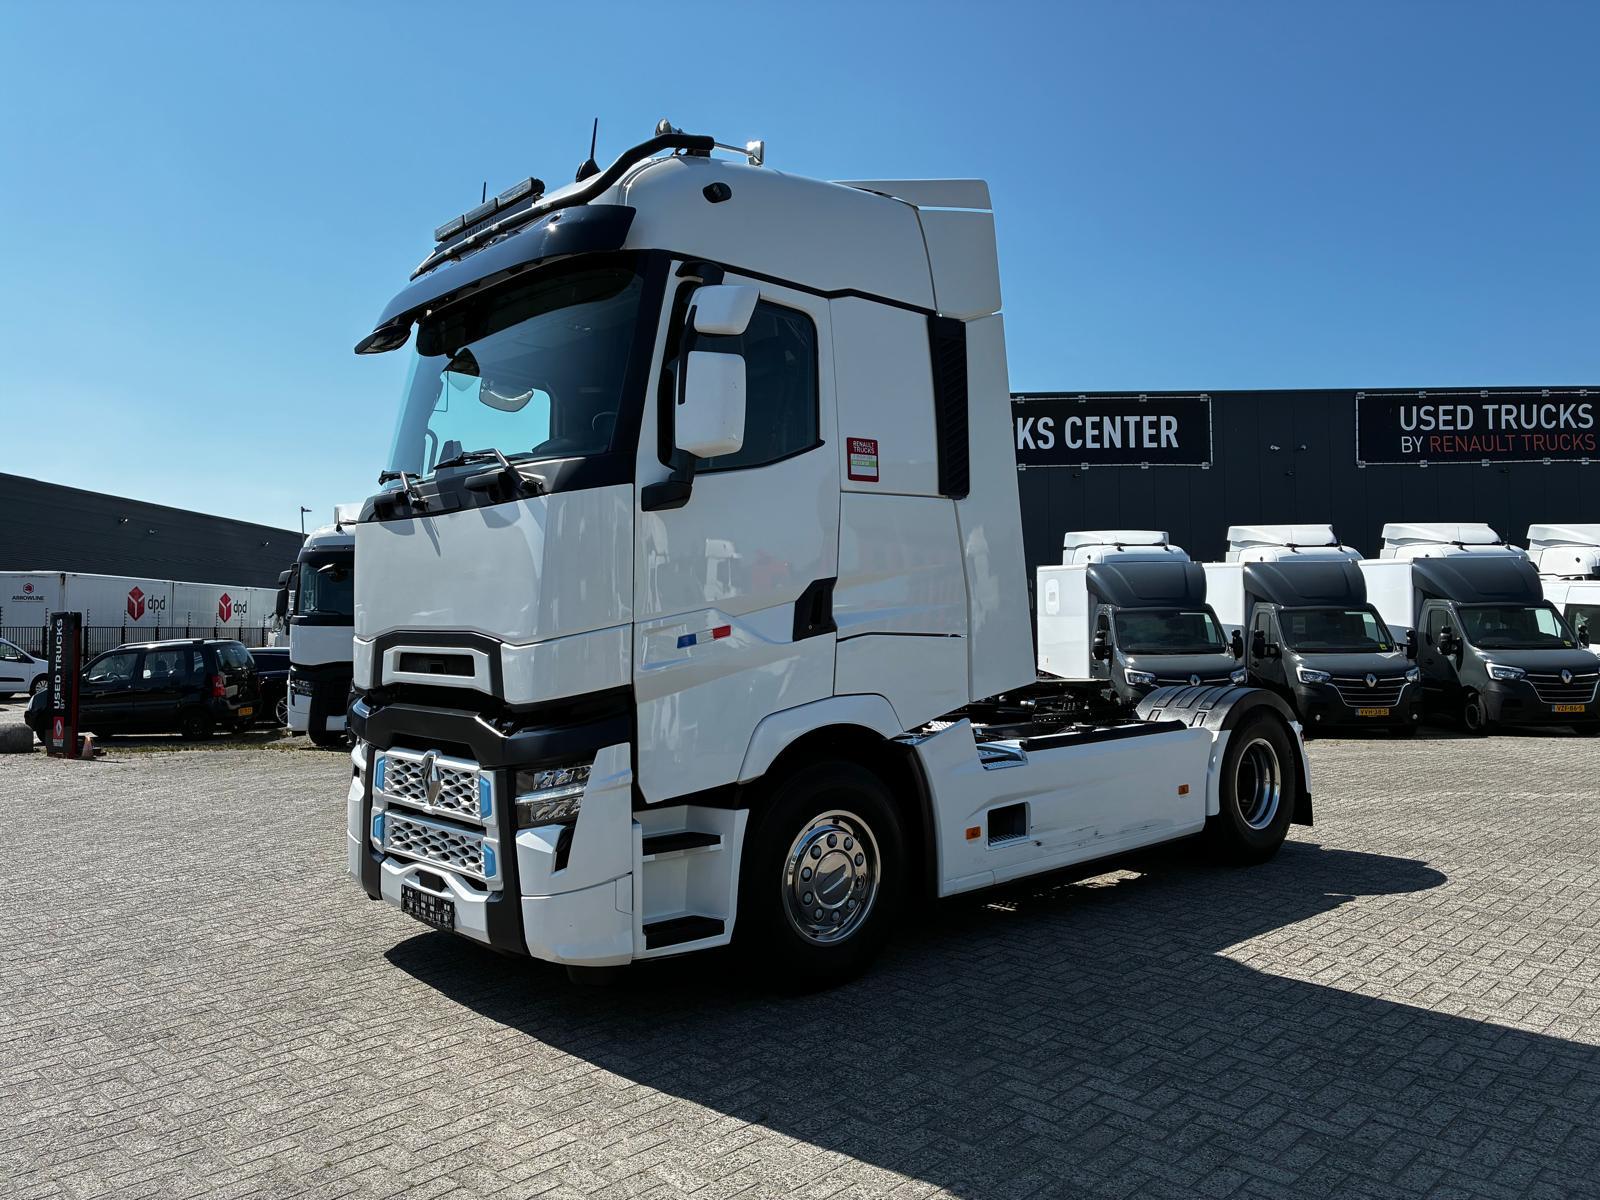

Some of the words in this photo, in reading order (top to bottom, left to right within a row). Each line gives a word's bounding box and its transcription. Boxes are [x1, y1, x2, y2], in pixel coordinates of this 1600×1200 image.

[1400, 405, 1474, 431] USED
[1482, 403, 1594, 430] TRUCKS
[1016, 417, 1055, 450] KS
[1064, 415, 1179, 449] CENTER
[1401, 436, 1424, 453] BY
[1429, 434, 1516, 453] RENAULT
[1520, 433, 1596, 451] TRUCKS
[147, 594, 166, 614] dpd
[233, 600, 248, 616] dpd
[55, 618, 63, 671] TRUCKS
[53, 674, 62, 709] USED
